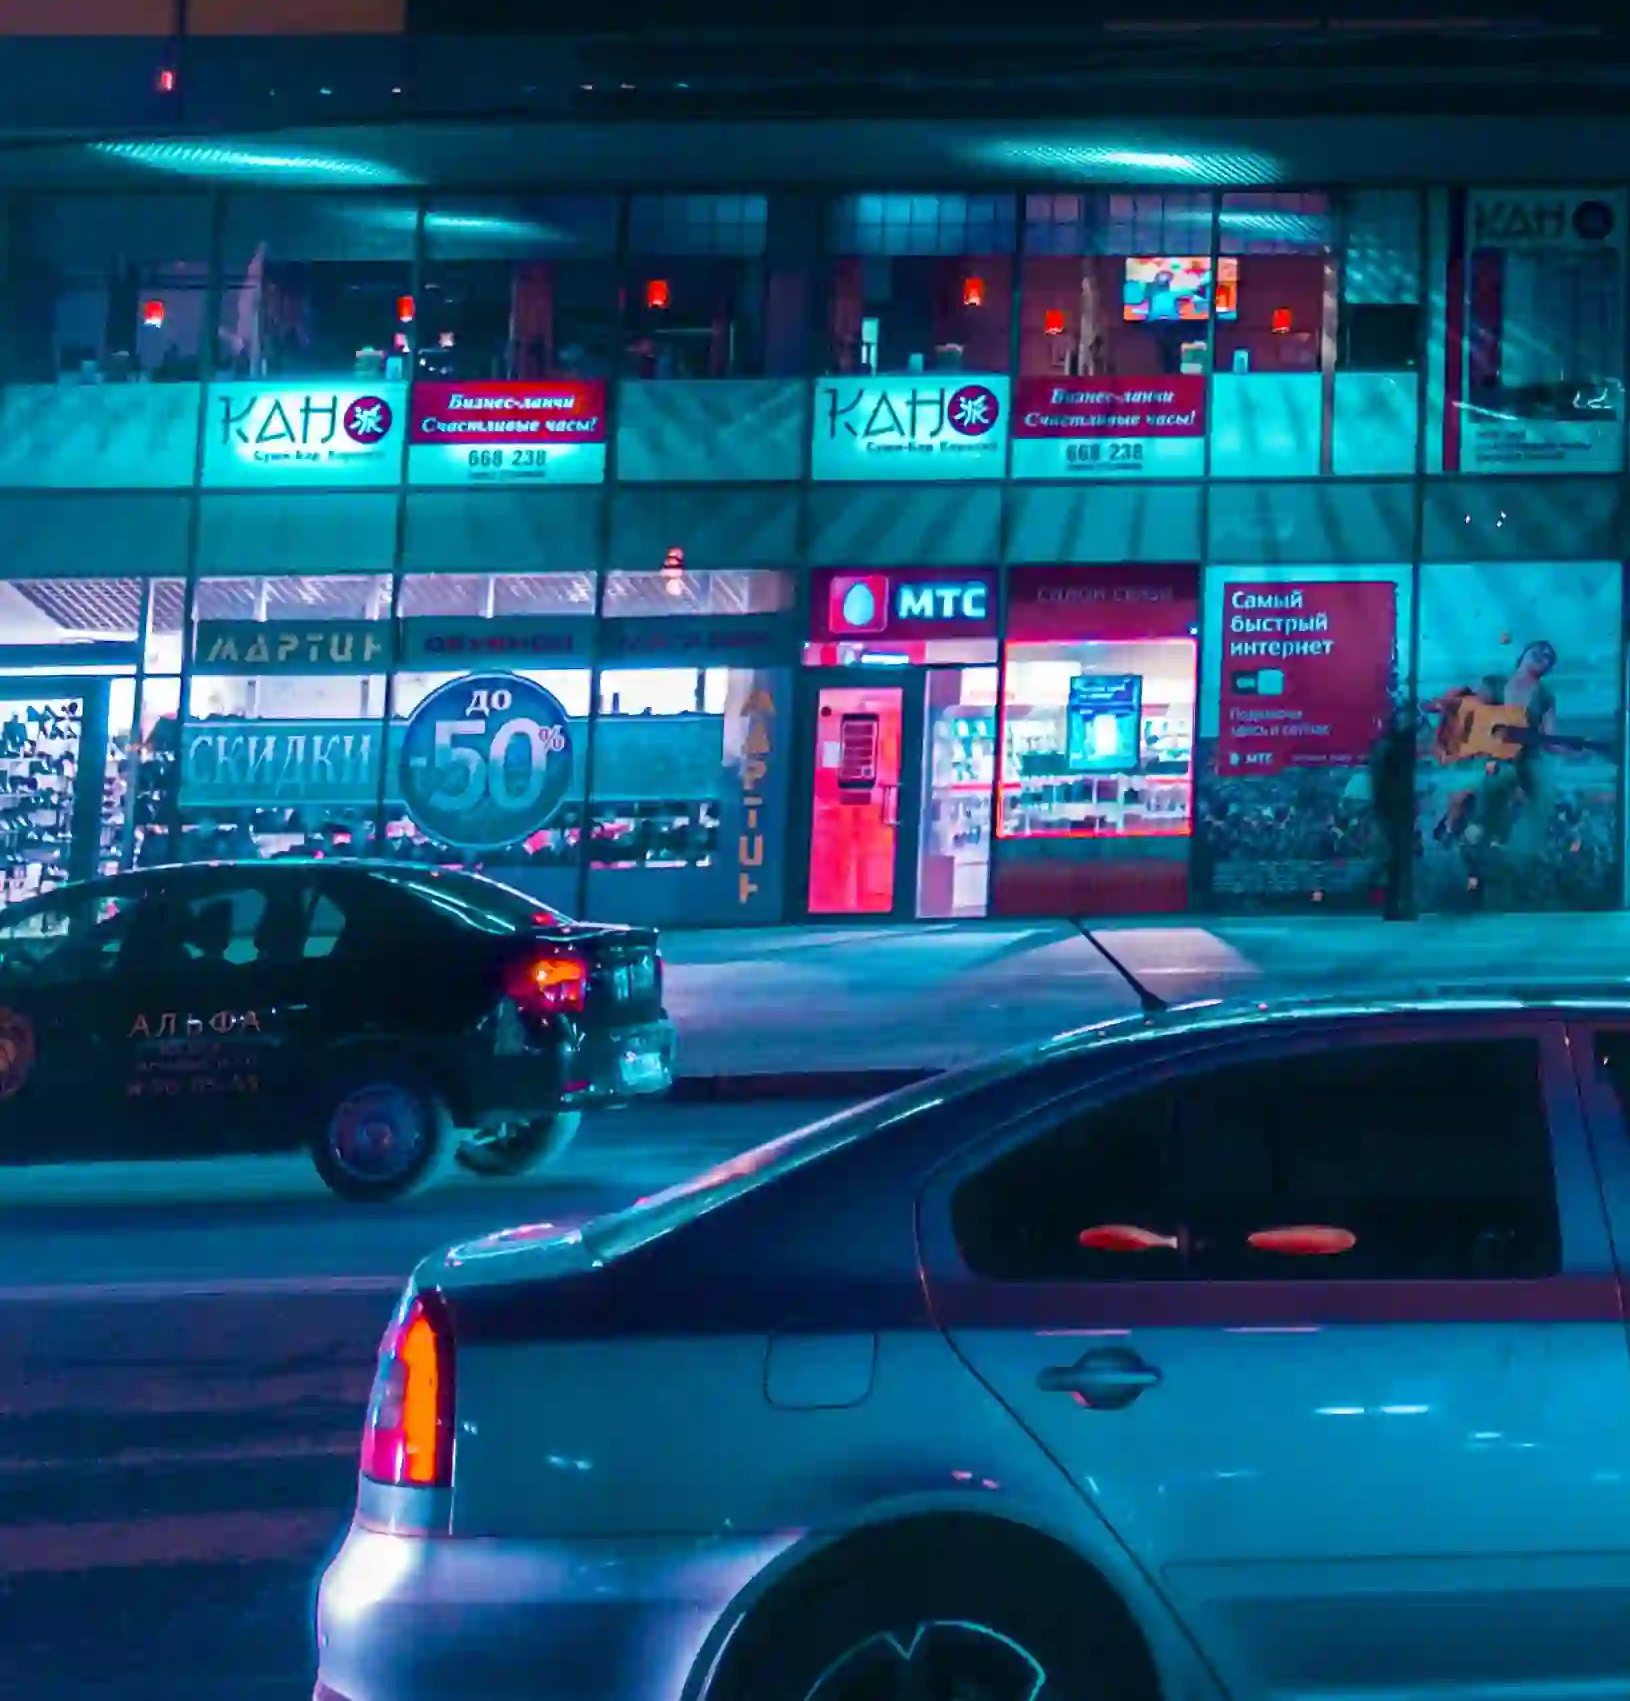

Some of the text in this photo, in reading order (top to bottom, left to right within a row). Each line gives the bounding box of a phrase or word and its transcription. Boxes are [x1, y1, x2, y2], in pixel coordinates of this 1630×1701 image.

[899, 583, 988, 620] МТС
[1231, 589, 1304, 610] Самый
[1230, 611, 1329, 636] быстрый
[1230, 639, 1335, 659] интернет
[186, 732, 371, 794] СКИДКИ
[125, 1009, 262, 1039] АЛЬФА
